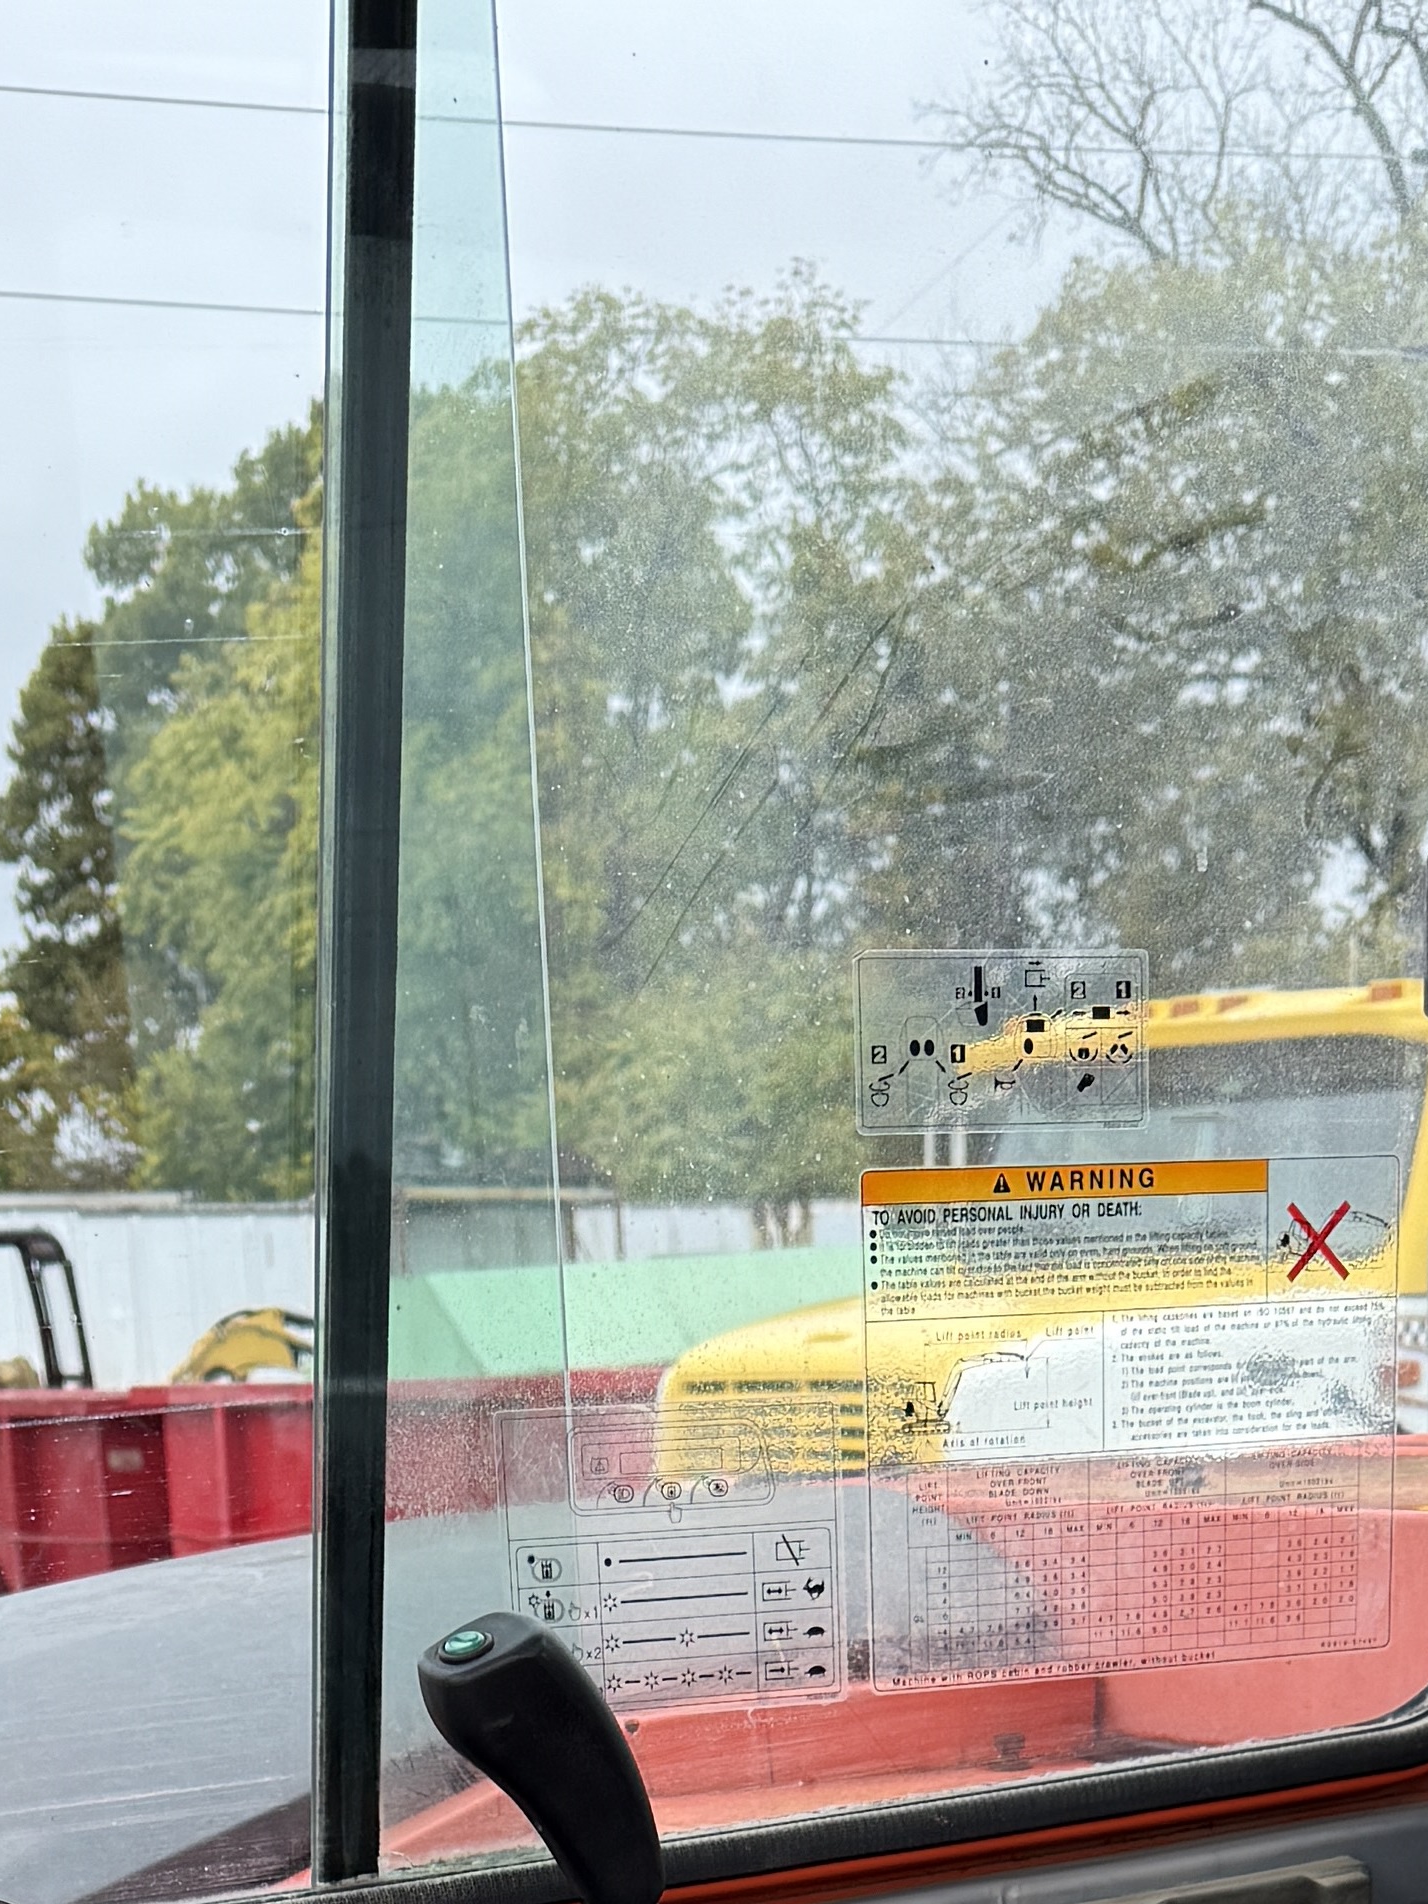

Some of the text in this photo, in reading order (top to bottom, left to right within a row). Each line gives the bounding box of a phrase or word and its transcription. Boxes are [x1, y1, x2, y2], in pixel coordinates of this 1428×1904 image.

[1073, 982, 1086, 998] 2
[872, 1045, 965, 1063] 2 1
[1027, 1168, 1155, 1192] WARNING
[873, 1202, 1143, 1226] TO AVOID PERSONAL INJURY OR DEATH:
[936, 1329, 1021, 1343] Lift point radius
[1046, 1326, 1064, 1337] Lift
[1014, 1401, 1031, 1411] Lift
[1062, 1398, 1093, 1409] height
[943, 1438, 965, 1448] Axis
[984, 1434, 1026, 1446] rotation
[967, 1670, 997, 1680] ROPS
